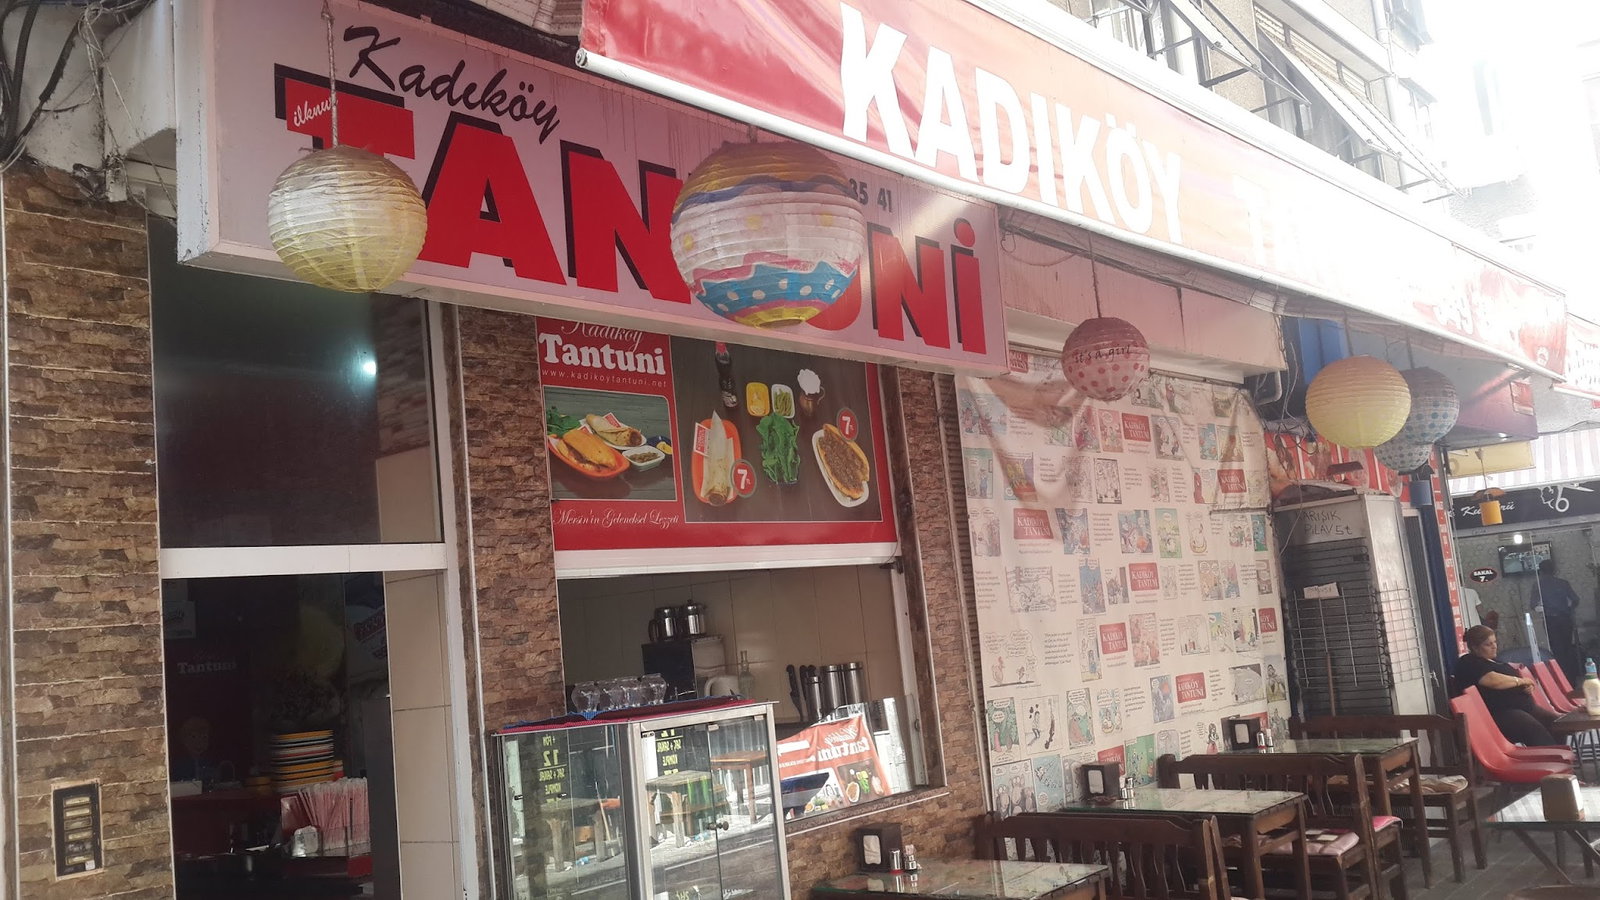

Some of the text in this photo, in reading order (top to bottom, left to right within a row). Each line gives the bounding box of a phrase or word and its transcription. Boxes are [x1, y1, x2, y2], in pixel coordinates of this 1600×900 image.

[840, 3, 1182, 244] KADIKÖY
[877, 188, 893, 213] 41
[538, 333, 666, 375] Tantuni
[1108, 344, 1131, 362] girl
[542, 370, 667, 388] www.kadikoytantuni.net
[737, 468, 748, 490] 7
